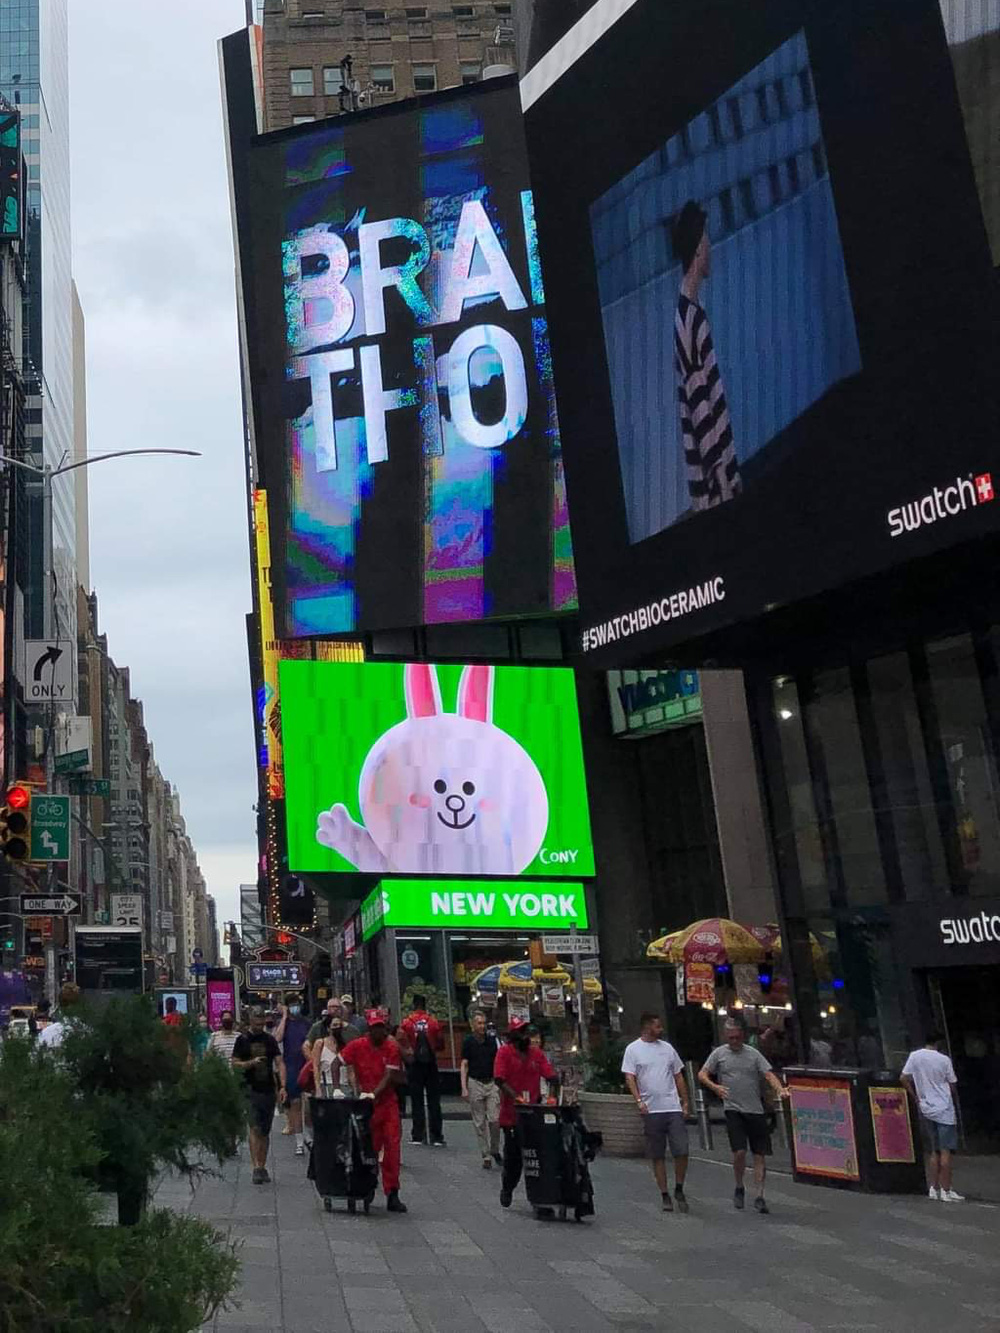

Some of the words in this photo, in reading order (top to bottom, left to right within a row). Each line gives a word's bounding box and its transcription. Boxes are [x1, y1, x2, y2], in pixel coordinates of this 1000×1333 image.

[887, 477, 978, 537] swatch
[582, 576, 726, 652] #SWATCHBIOCERAMIC
[32, 685, 66, 697] ONLY
[431, 892, 495, 916] NEW
[501, 893, 577, 917] YORK
